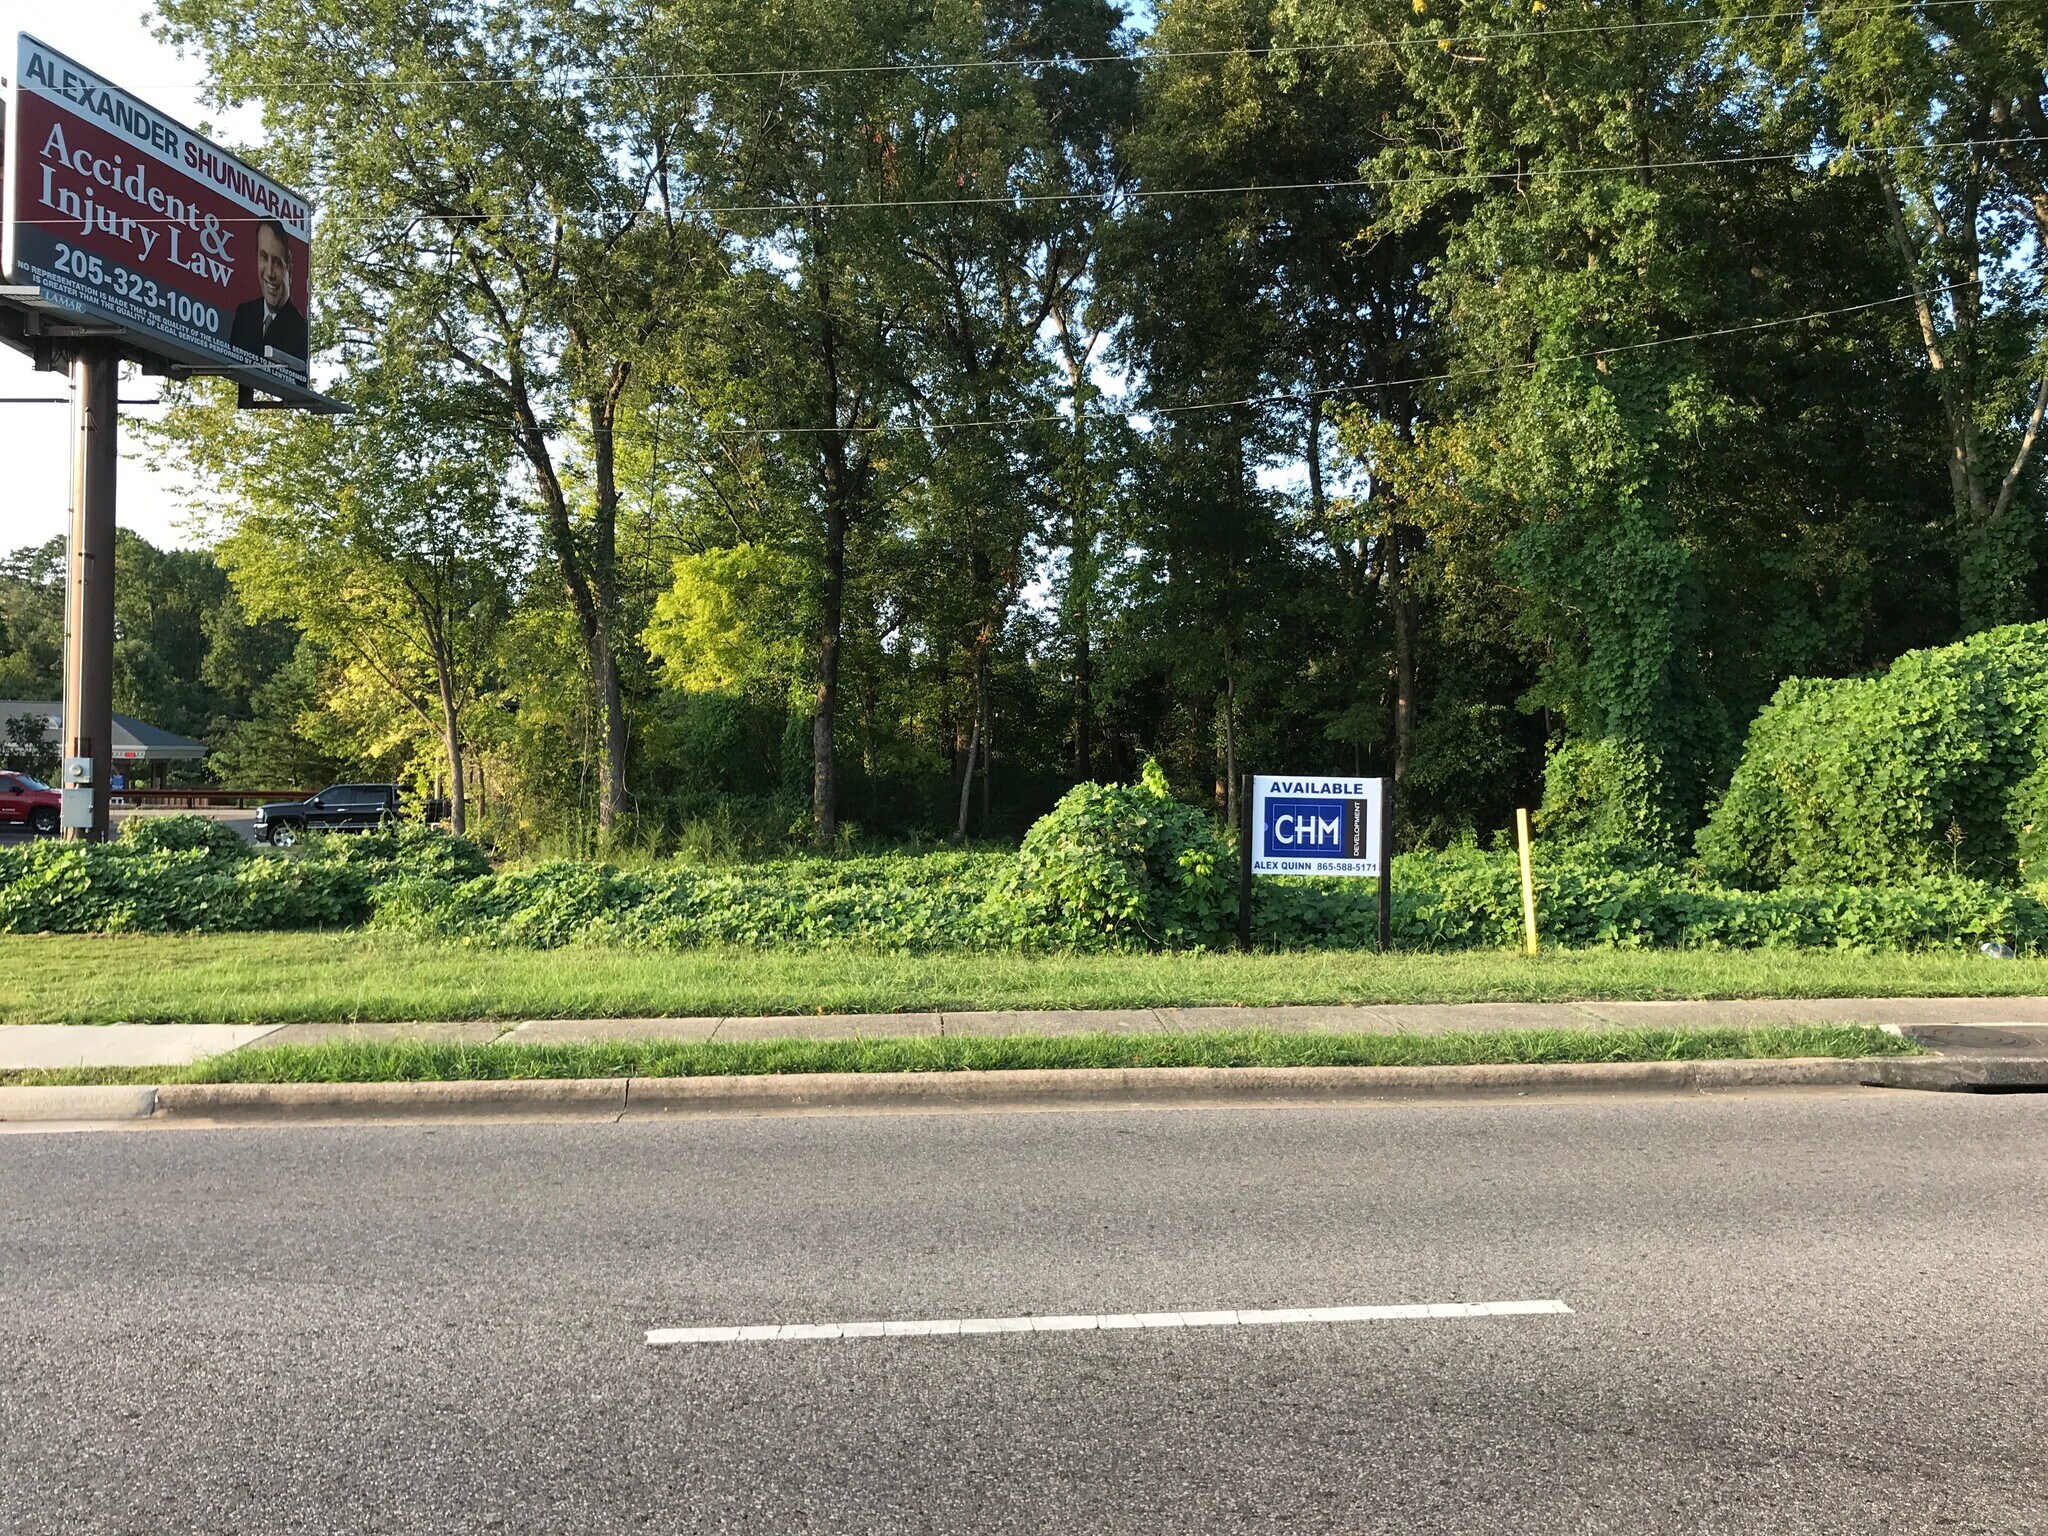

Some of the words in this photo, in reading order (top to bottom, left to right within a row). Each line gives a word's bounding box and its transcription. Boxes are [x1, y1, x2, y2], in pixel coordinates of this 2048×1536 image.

[26, 52, 178, 159] ALEXANDER
[184, 141, 305, 232] SHUNNARAH
[38, 162, 160, 262] Injury
[167, 225, 234, 288] Law
[17, 260, 29, 271] NO
[31, 265, 98, 297] REPRESENTATION
[99, 291, 107, 300] IS
[108, 294, 128, 309] MADE
[129, 303, 147, 316] THAT
[148, 311, 161, 322] THE
[162, 317, 190, 334] QUALITY
[190, 328, 199, 337] OF
[200, 332, 212, 342] THE
[213, 337, 231, 350] LEGAL
[232, 345, 259, 362] SERVICES
[259, 356, 267, 364] TO
[32, 274, 41, 284] IS
[42, 278, 78, 297] GREATER
[78, 291, 99, 305] THAN
[100, 299, 114, 311] THE
[116, 305, 146, 323] QUALITY
[146, 317, 156, 327] OF
[156, 321, 177, 336] LEGAL
[178, 331, 208, 348] SERVICES
[209, 343, 244, 362] PERFORMED
[45, 291, 82, 312] LAMAR
[54, 243, 219, 333] 205-323-1000
[1270, 782, 1363, 795] AVAILABLE
[1275, 814, 1339, 845] CHM
[1254, 861, 1278, 870] ALEX
[1281, 862, 1312, 870] QUINN
[1316, 862, 1376, 872] 865-588-5171
